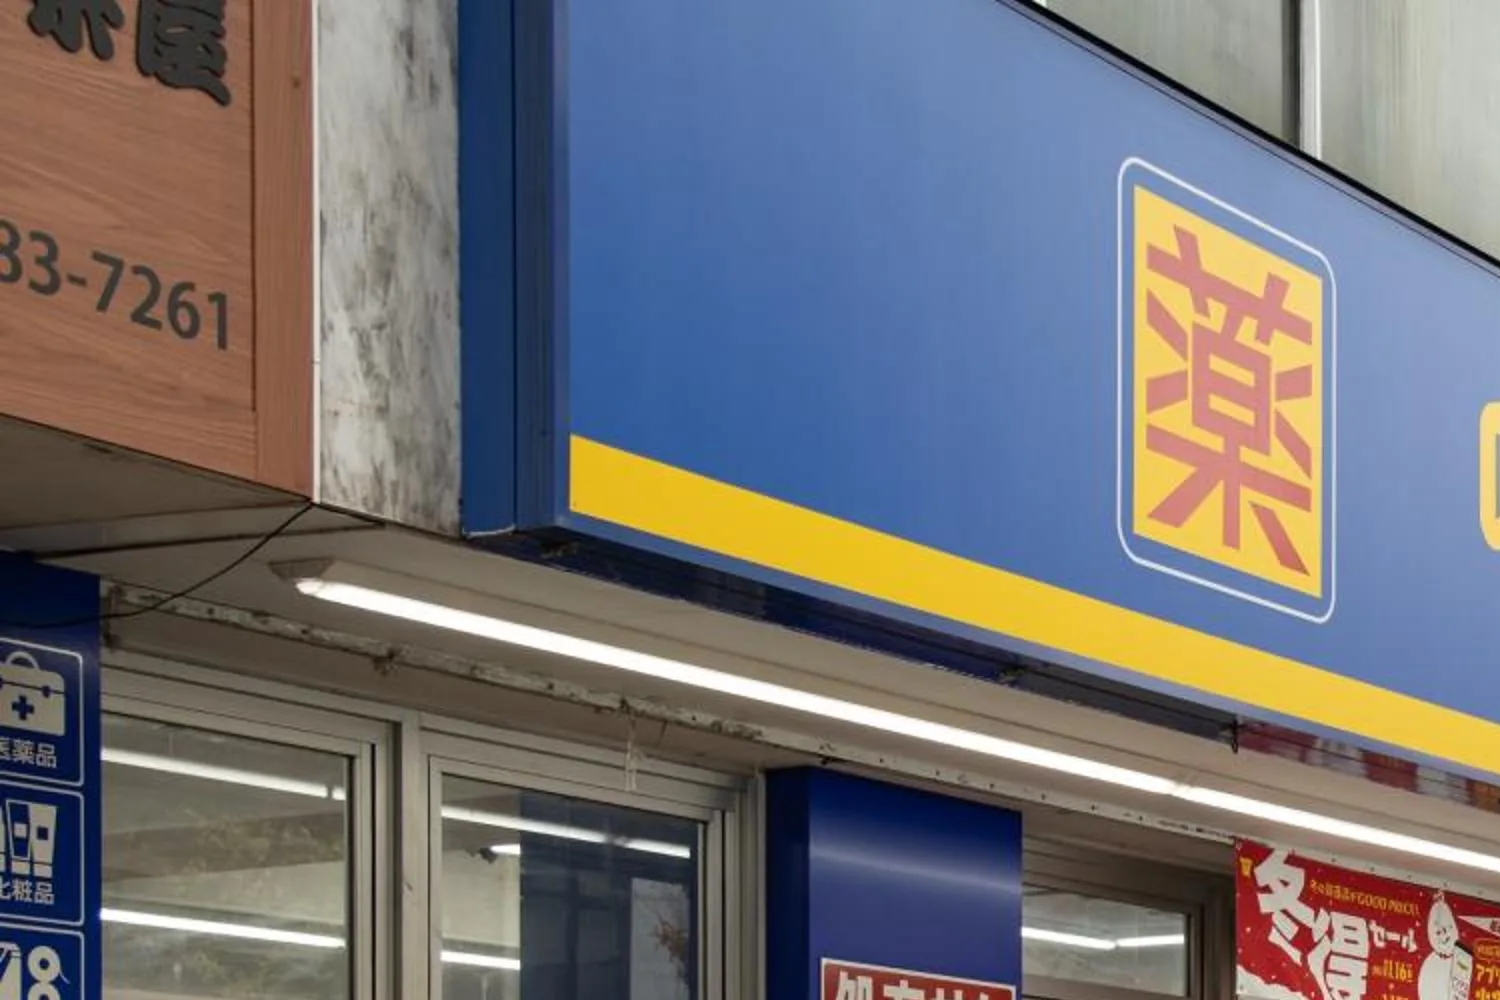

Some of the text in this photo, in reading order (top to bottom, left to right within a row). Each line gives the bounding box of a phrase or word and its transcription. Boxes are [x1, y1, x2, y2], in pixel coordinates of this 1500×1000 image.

[1145, 223, 1313, 577] 薬
[1368, 920, 1418, 953] セール
